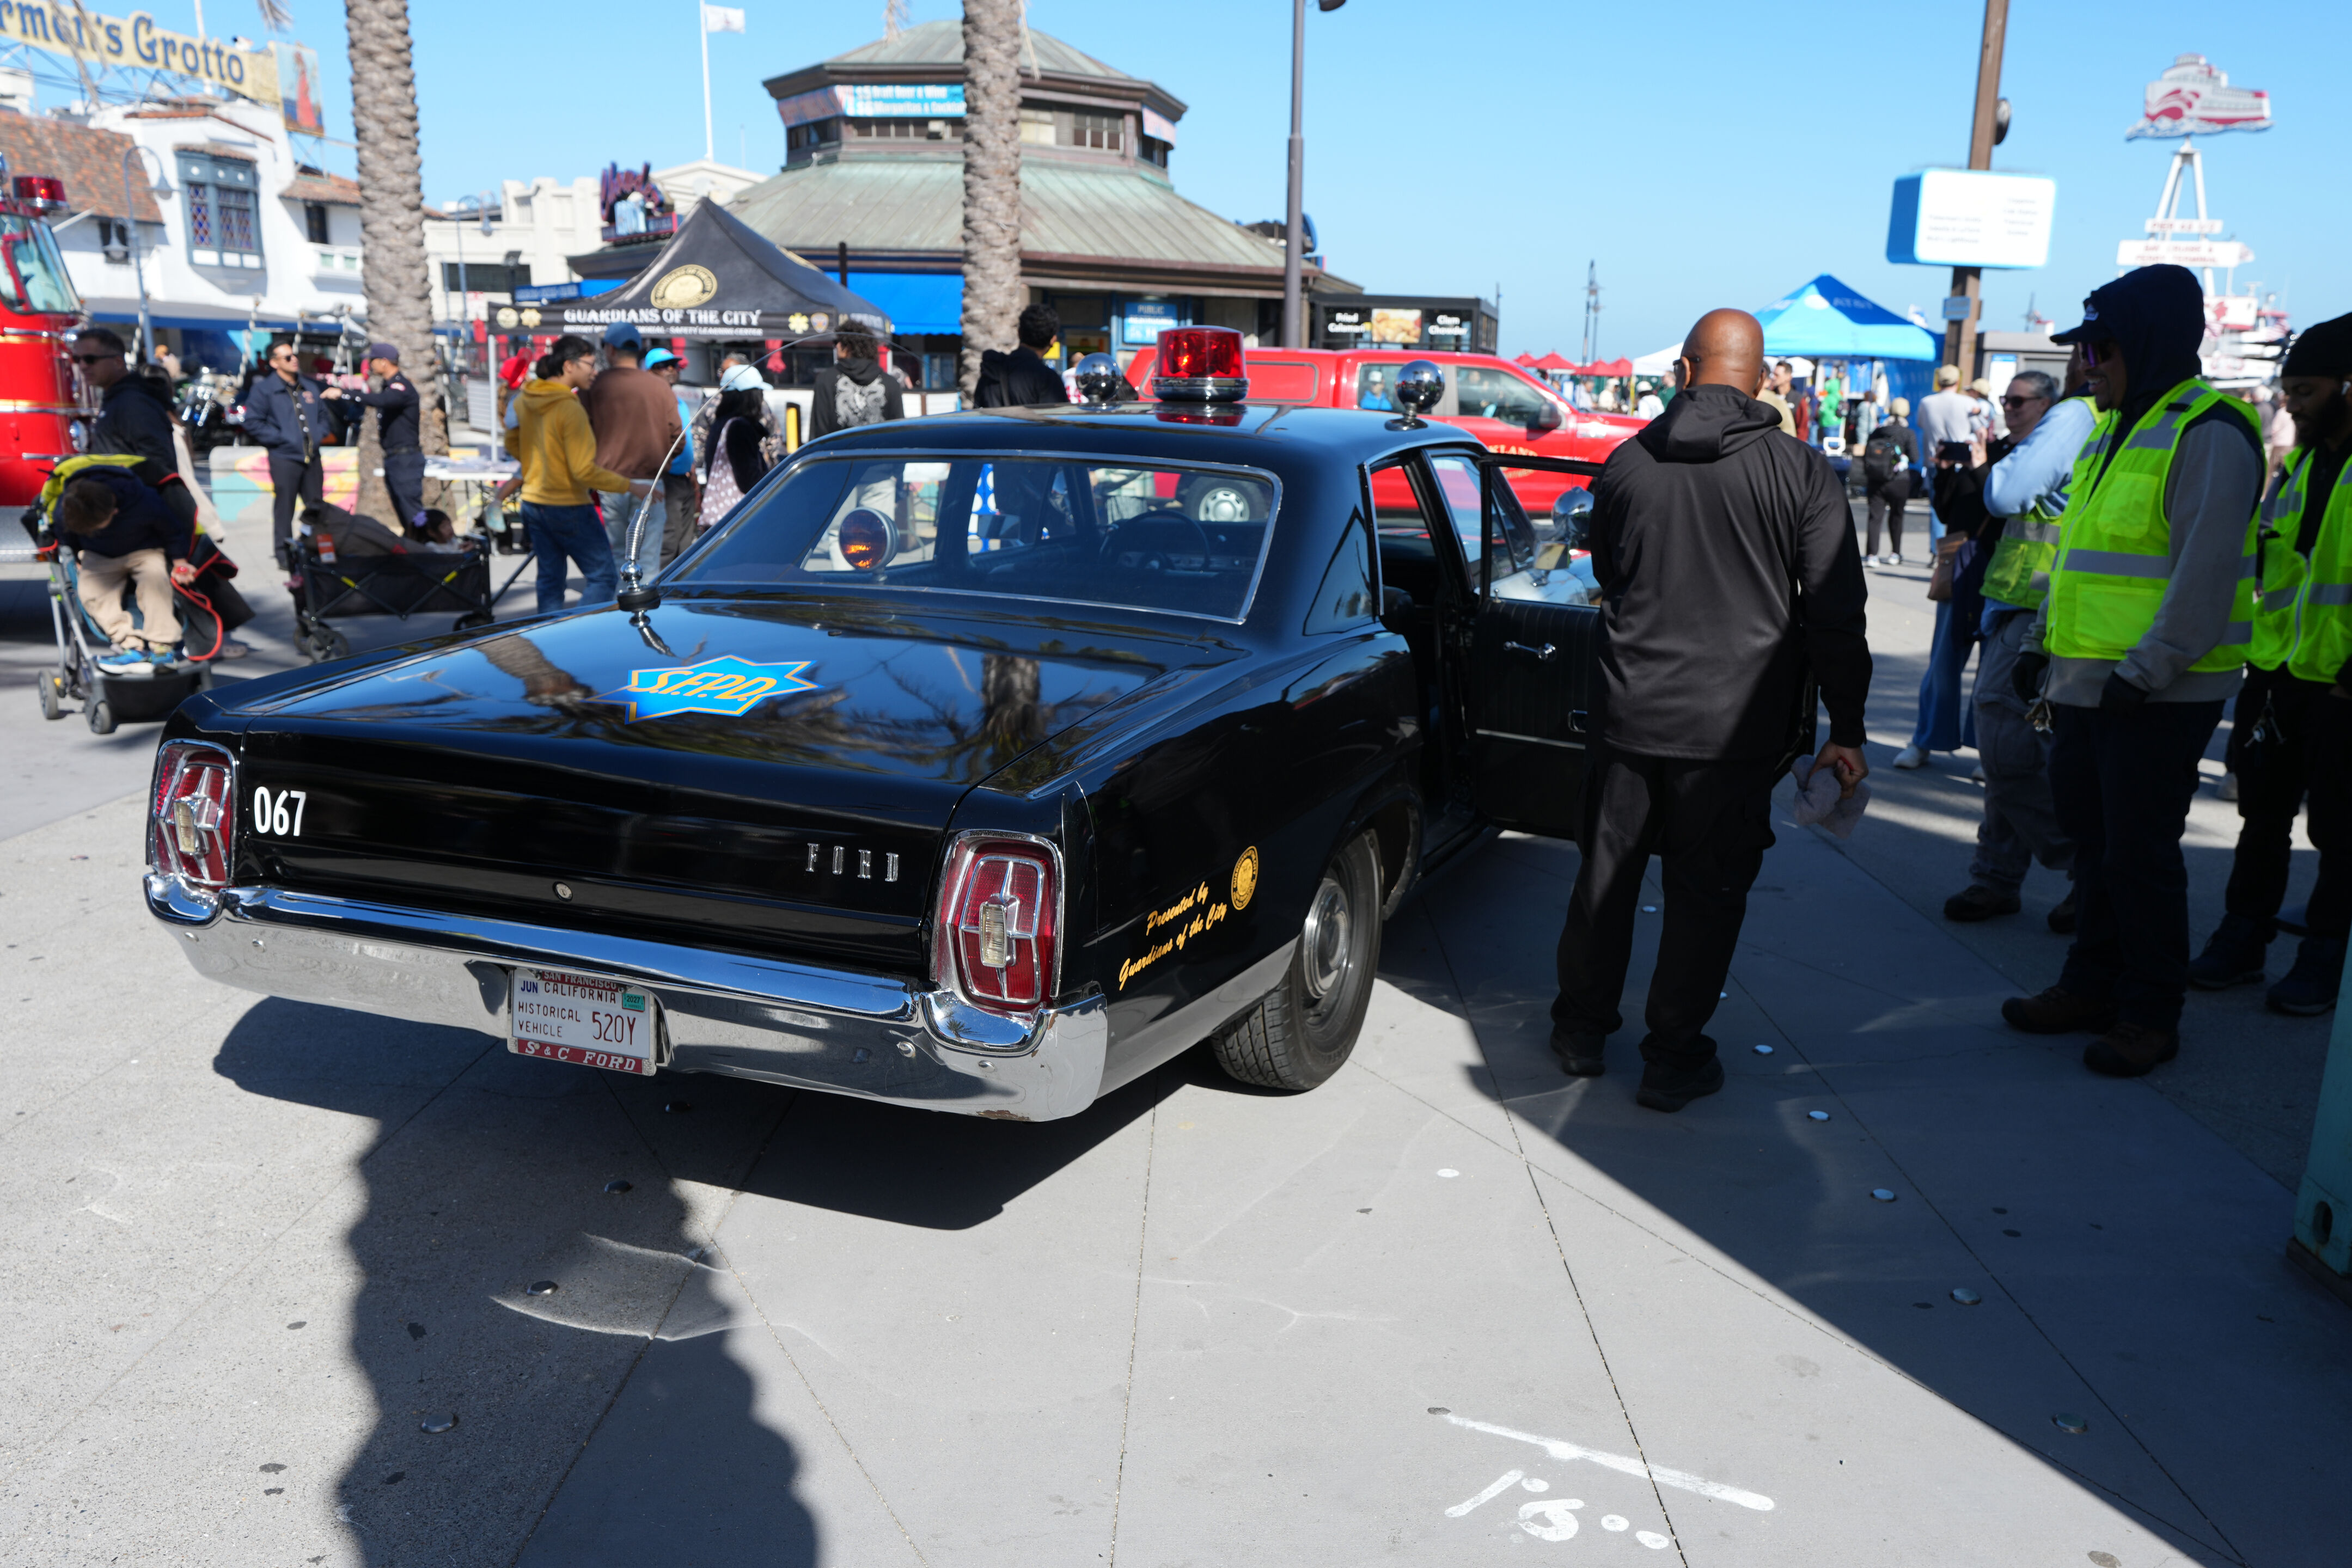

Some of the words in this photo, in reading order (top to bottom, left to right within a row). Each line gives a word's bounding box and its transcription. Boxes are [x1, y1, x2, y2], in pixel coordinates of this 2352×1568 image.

[133, 15, 244, 84] Grotto
[564, 309, 661, 323] GUARDIANS
[662, 309, 684, 323] OF
[686, 309, 720, 324] THE
[722, 309, 762, 326] CITY
[1137, 305, 1165, 315] PUBLIC
[1335, 313, 1359, 322] Fried
[1328, 322, 1366, 333] Calamari
[1437, 315, 1461, 325] Clam
[1428, 325, 1469, 335] Chowder
[254, 786, 307, 836] 067
[806, 842, 899, 882] FORD
[1146, 889, 1196, 935] Presented
[1197, 881, 1209, 905] by
[1119, 938, 1174, 990] Guardians
[1176, 923, 1188, 950] of
[1189, 913, 1204, 938] the
[1206, 903, 1227, 930] City
[521, 981, 538, 994] JUN
[544, 972, 561, 981] SAN
[565, 974, 616, 989] FRANCISCO
[545, 982, 616, 1004] CALIFORNIA
[626, 995, 640, 1003] 2027
[518, 1001, 581, 1022] HISTORICAL
[518, 1020, 563, 1038] VEHICLE
[592, 1011, 636, 1045] 520Y
[525, 1040, 537, 1055] S
[544, 1046, 551, 1056] &
[558, 1047, 570, 1059] C
[583, 1051, 636, 1071] FORD
